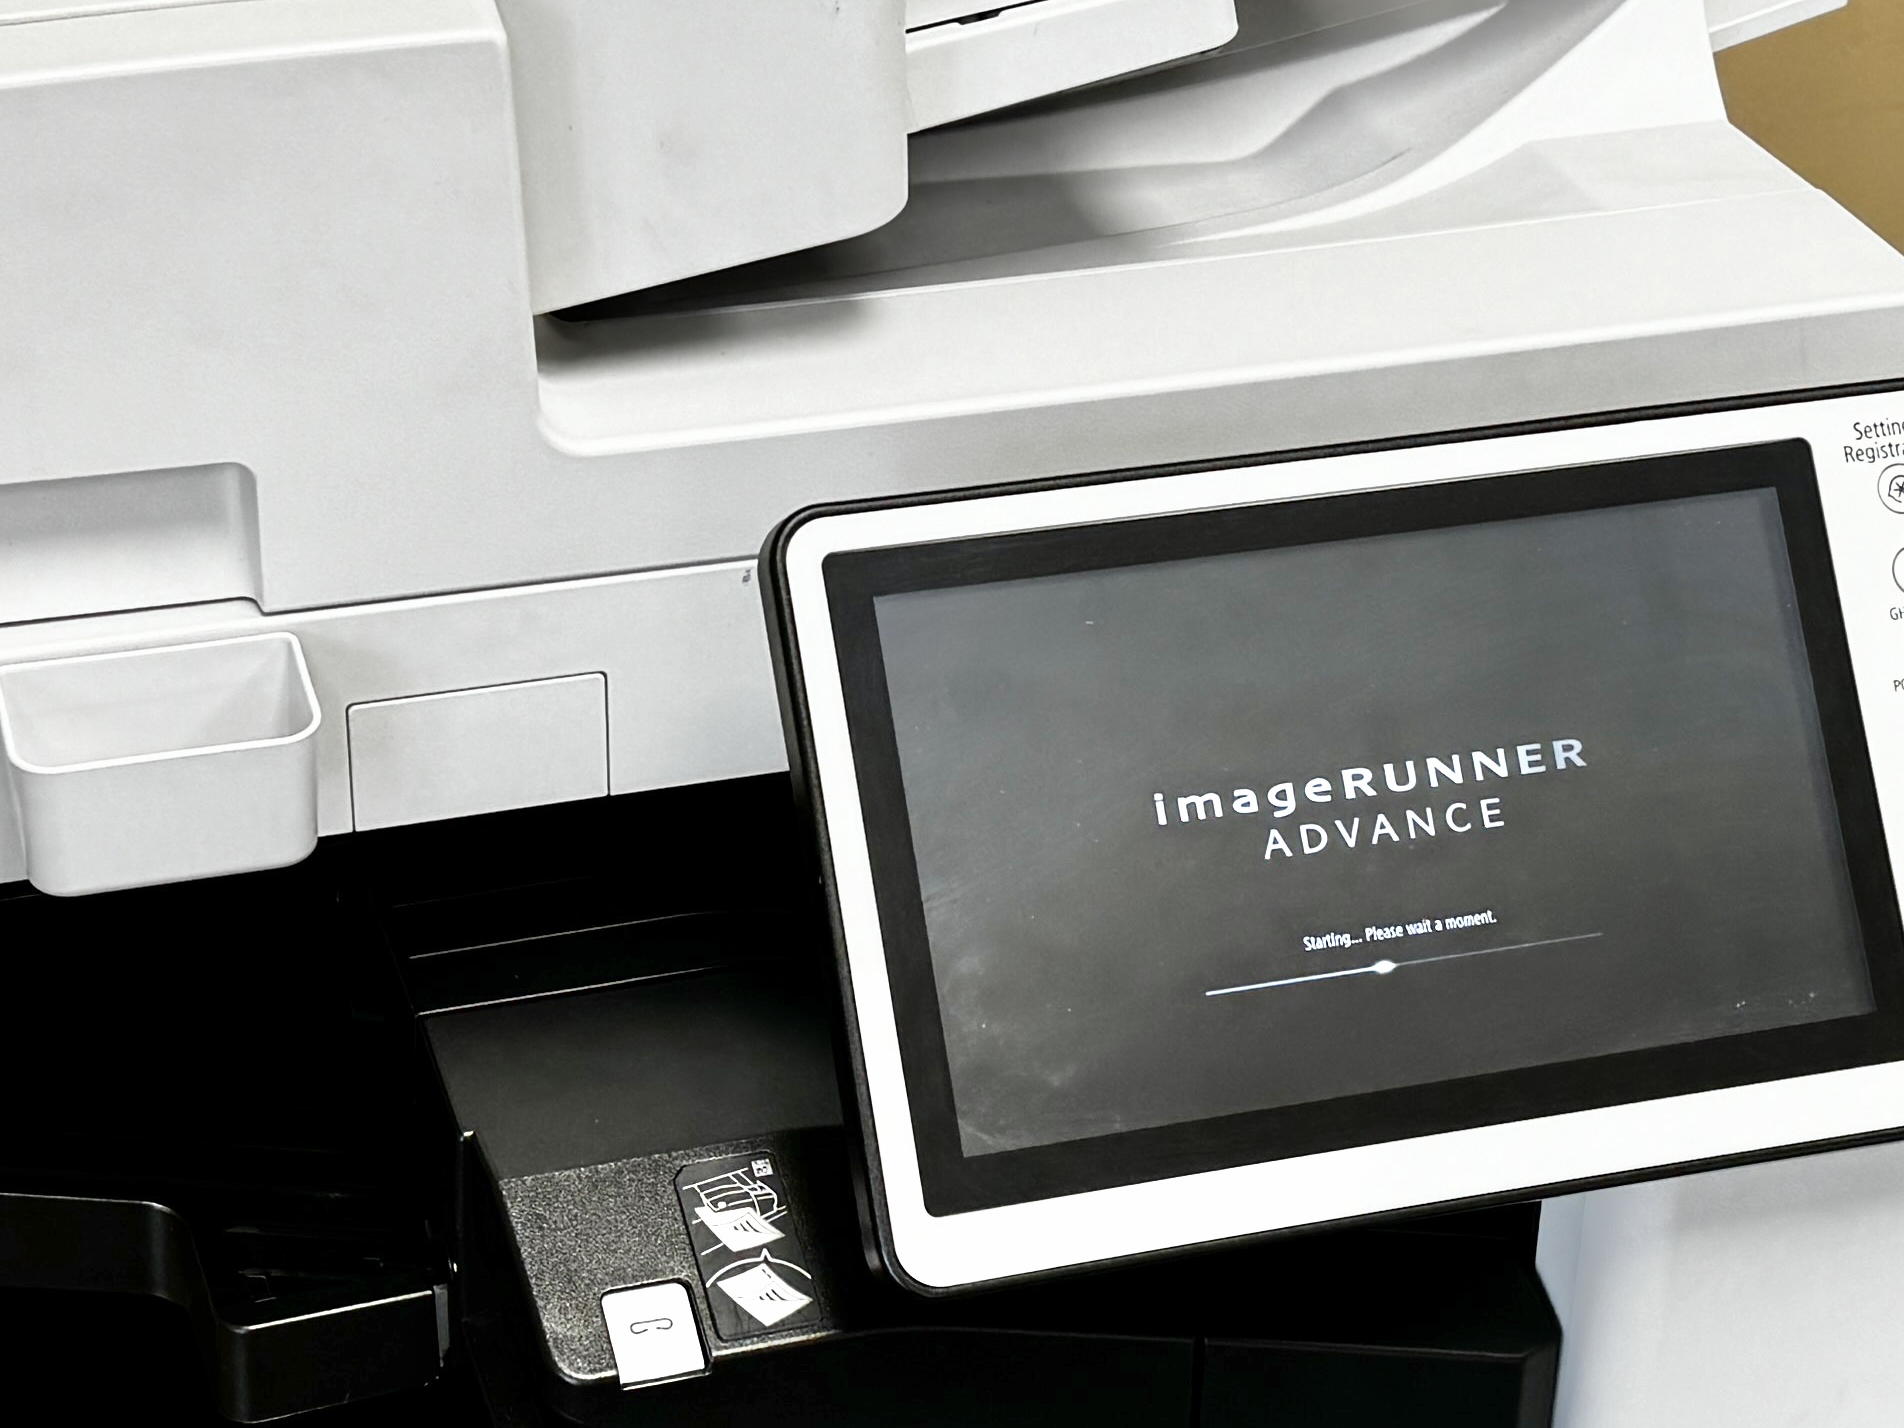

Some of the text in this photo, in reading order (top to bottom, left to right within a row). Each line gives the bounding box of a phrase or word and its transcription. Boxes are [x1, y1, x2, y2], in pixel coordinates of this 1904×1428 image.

[1153, 738, 1587, 826] imageRUNNER
[1264, 797, 1505, 860] ADVANCE
[1303, 909, 1497, 951] Starting... Please wait a moment.
